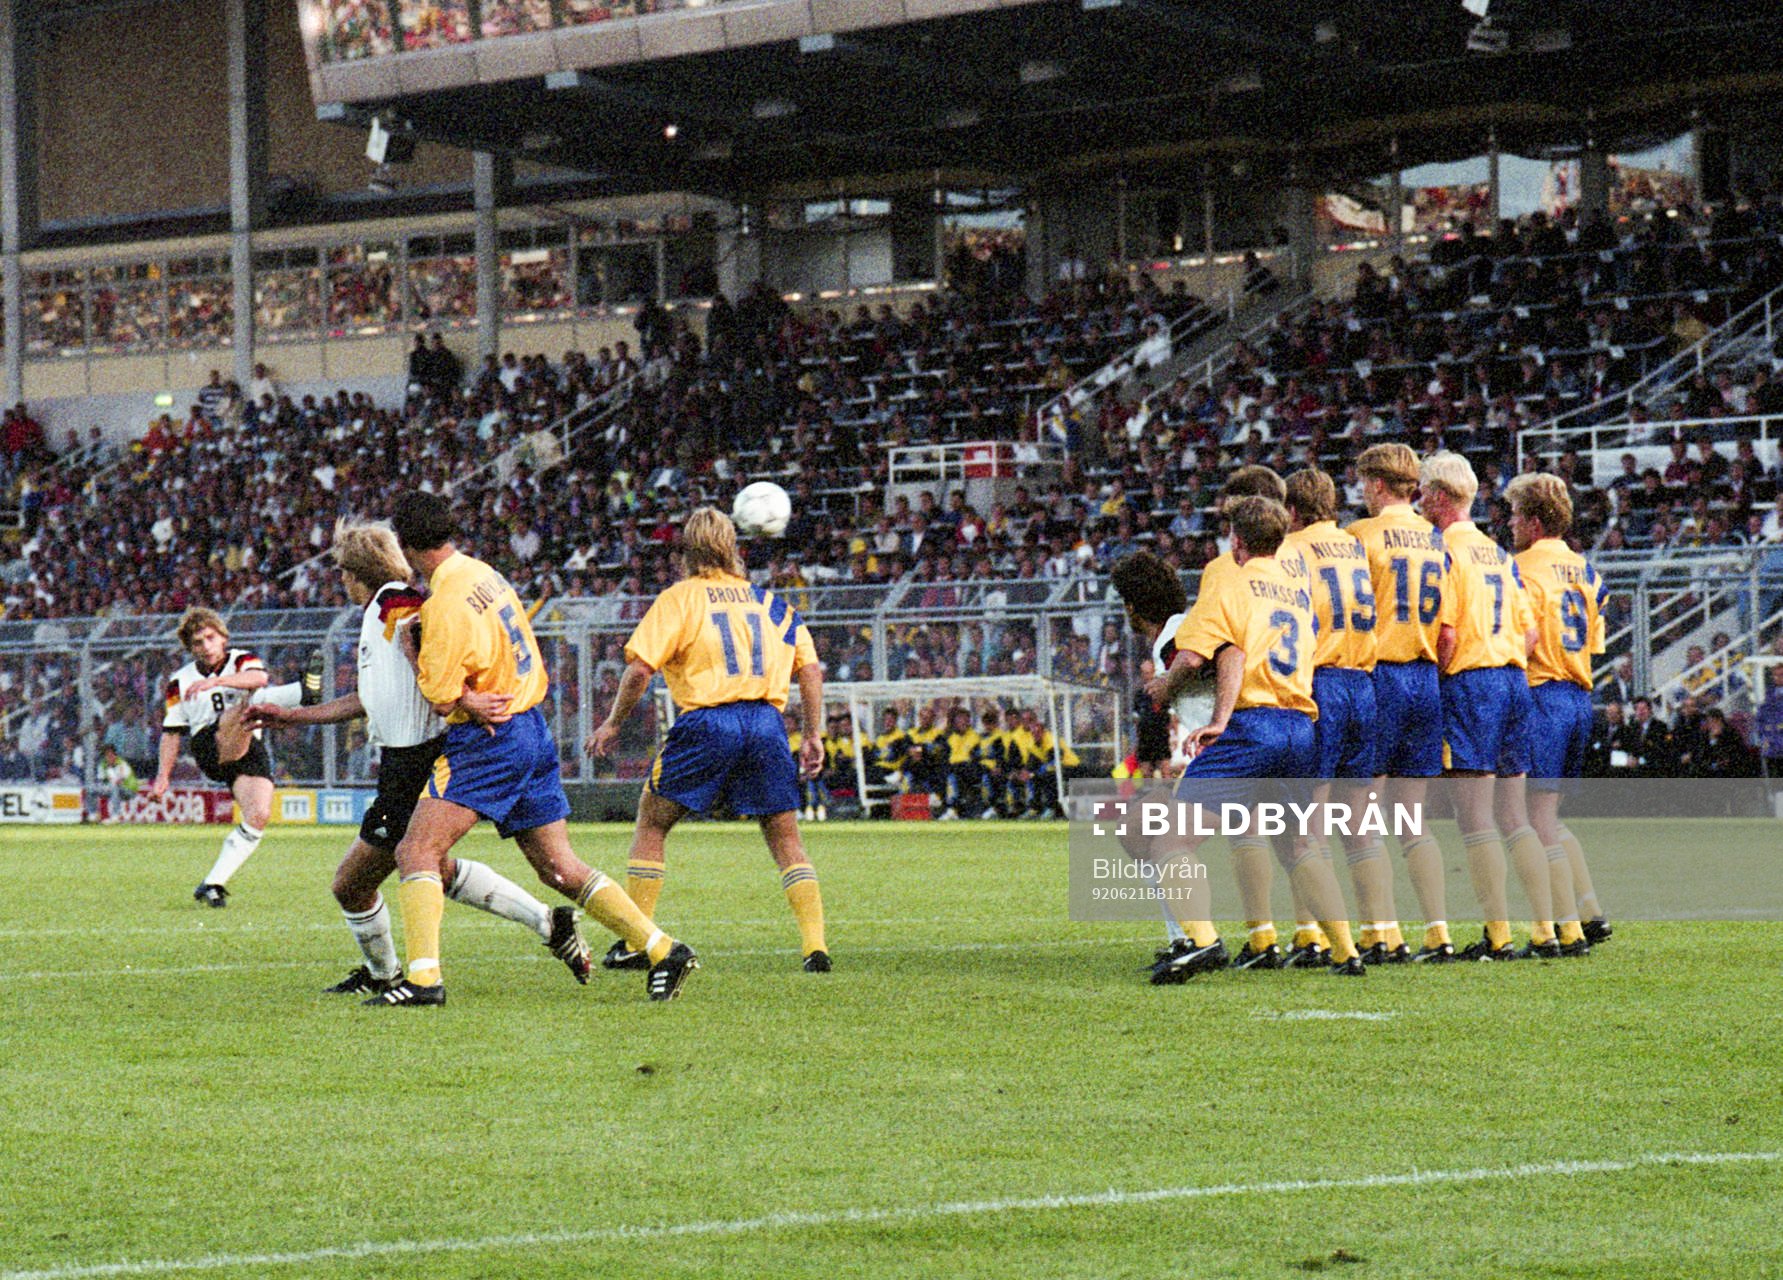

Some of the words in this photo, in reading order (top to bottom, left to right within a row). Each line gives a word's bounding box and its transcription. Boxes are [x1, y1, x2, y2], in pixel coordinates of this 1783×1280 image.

[1390, 556, 1442, 625] 16
[1484, 573, 1503, 634] 7
[1561, 590, 1588, 652] 9
[498, 604, 532, 675] 5
[711, 612, 764, 675] 11
[1268, 610, 1298, 676] 3
[211, 692, 224, 712] 8
